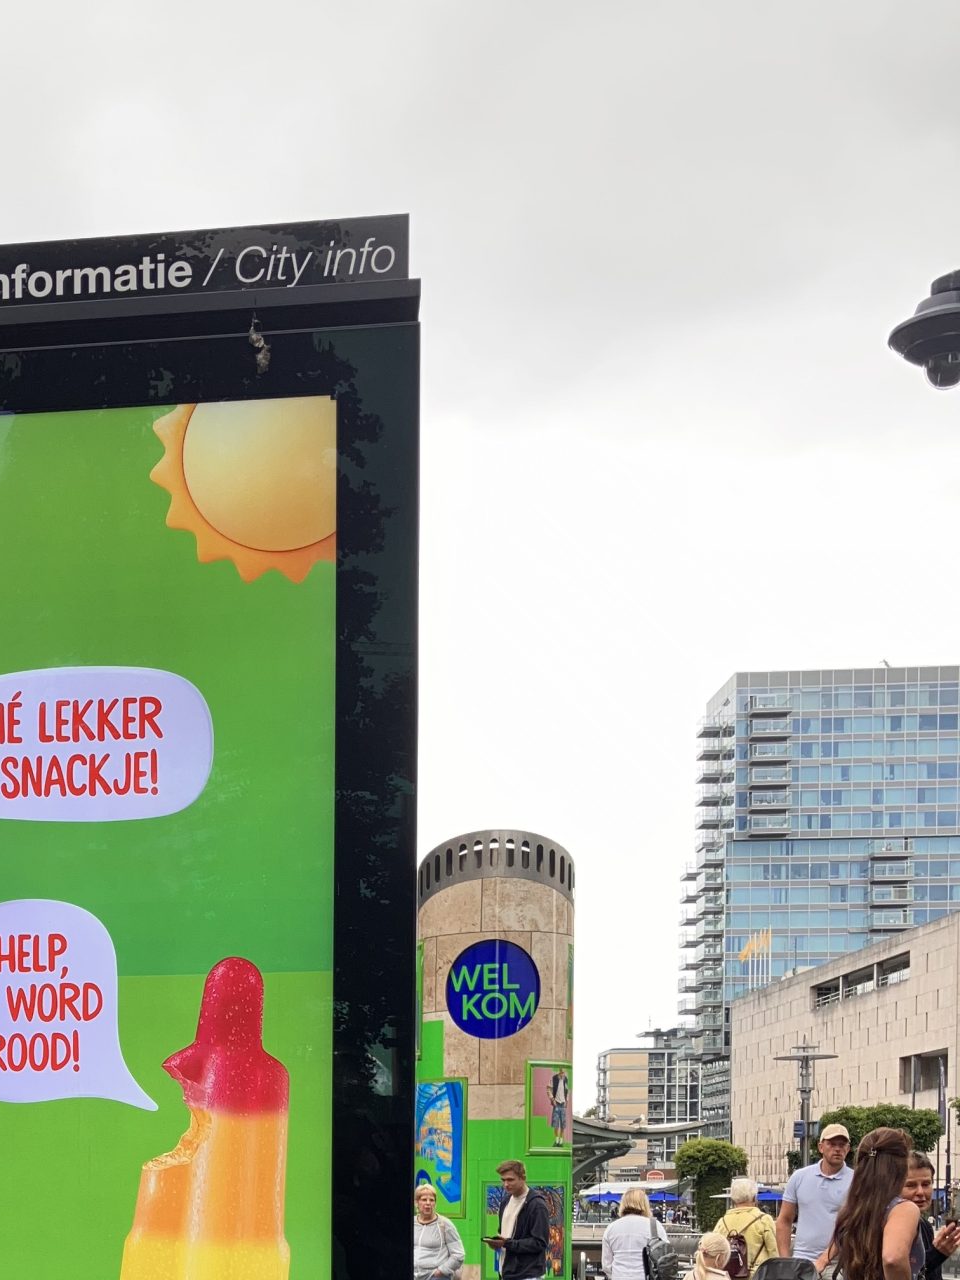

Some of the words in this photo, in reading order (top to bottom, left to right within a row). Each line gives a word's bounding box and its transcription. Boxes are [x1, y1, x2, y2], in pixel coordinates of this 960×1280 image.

[202, 247, 225, 287] /
[235, 244, 313, 287] City
[323, 237, 395, 277] info
[39, 696, 163, 742] LEKKER
[0, 752, 158, 799] SNACKJE!
[451, 963, 520, 992] WEL
[6, 983, 103, 1022] WORD
[462, 991, 535, 1021] KOM
